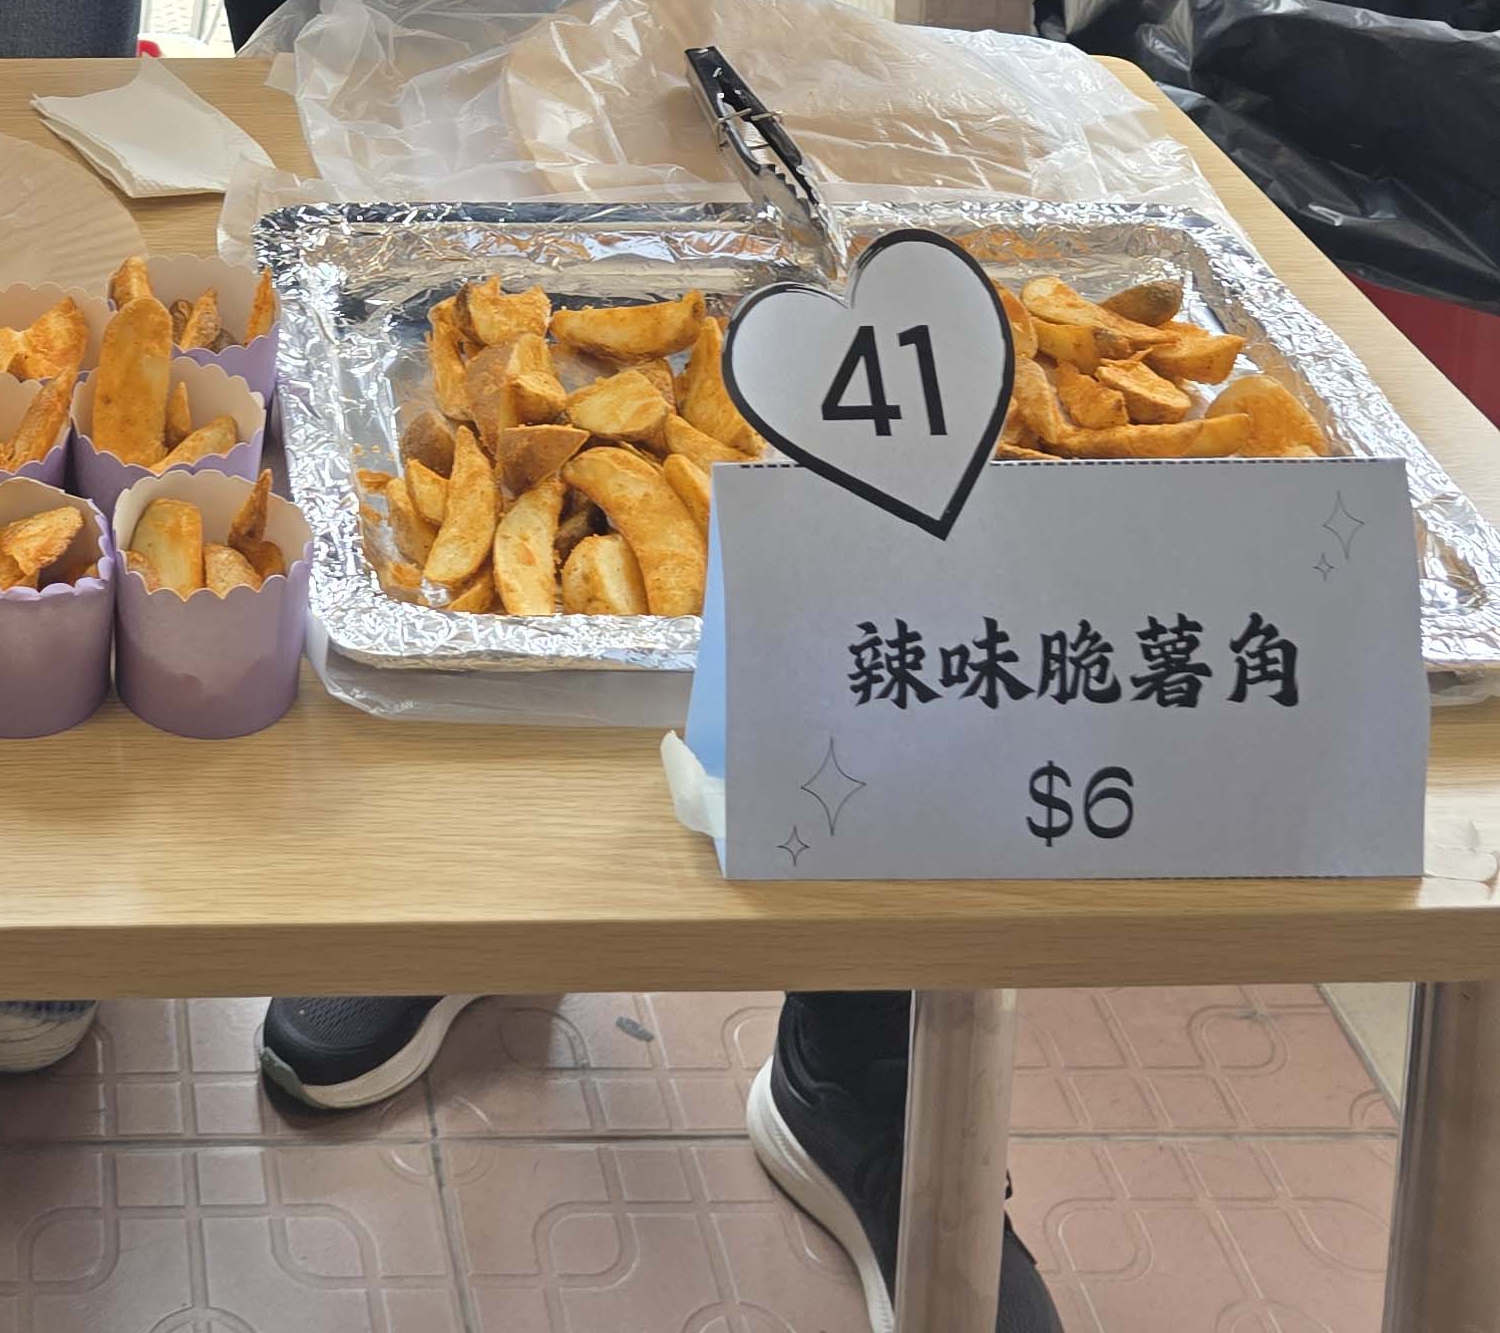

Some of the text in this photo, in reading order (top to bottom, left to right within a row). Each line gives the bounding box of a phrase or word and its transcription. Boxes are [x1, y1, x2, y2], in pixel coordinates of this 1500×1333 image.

[821, 324, 948, 437] 41
[847, 611, 1302, 711] 辣味脆薯角
[1024, 759, 1136, 848] $6
